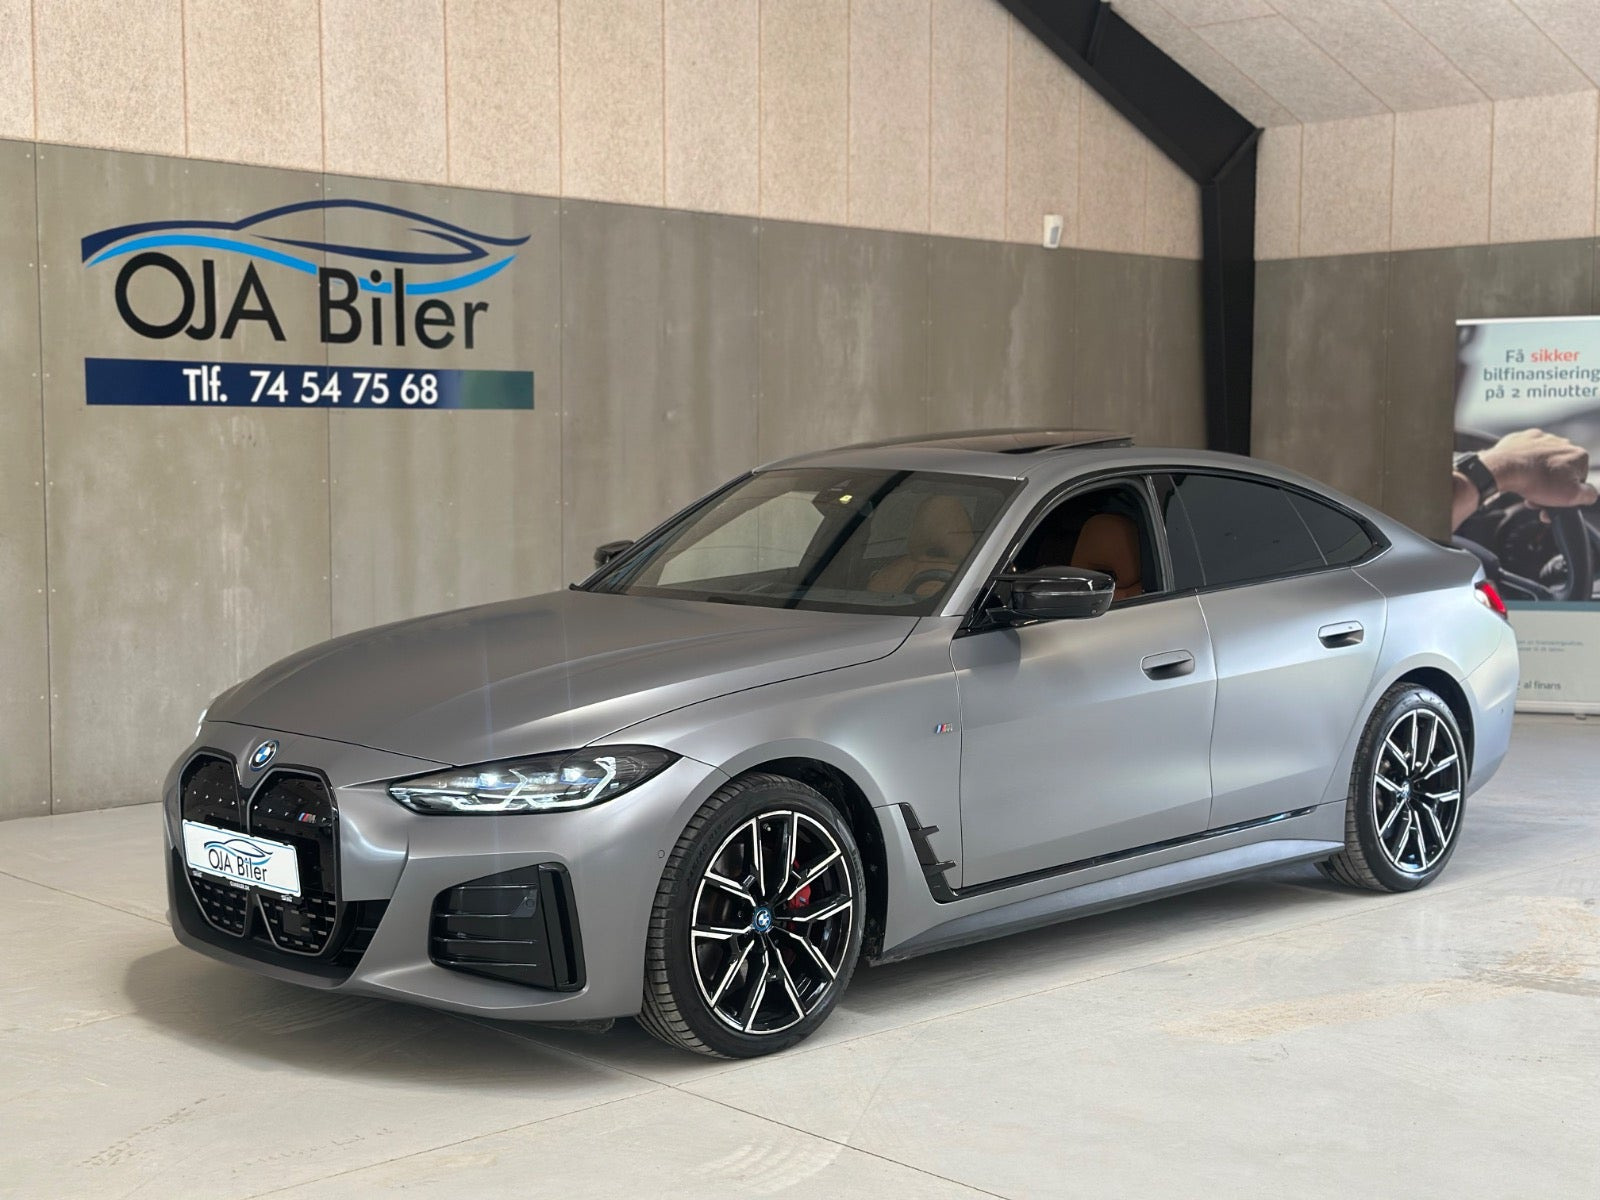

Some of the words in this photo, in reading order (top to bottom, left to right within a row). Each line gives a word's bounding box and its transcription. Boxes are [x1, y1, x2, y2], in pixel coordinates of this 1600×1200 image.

[114, 252, 287, 342] OJA
[318, 267, 490, 350] Biler
[1505, 349, 1525, 363] Få
[1530, 348, 1580, 363] sikker
[183, 365, 228, 403] Tlf.
[250, 370, 289, 403] 74
[300, 371, 342, 404] 54
[352, 372, 390, 405] 75
[400, 373, 439, 405] 68
[1483, 365, 1600, 383] bilfinansiering
[1485, 384, 1505, 401] på
[1511, 388, 1521, 398] 2
[1526, 384, 1598, 399] minutter
[208, 848, 234, 874] OJA
[237, 855, 268, 882] Biler
